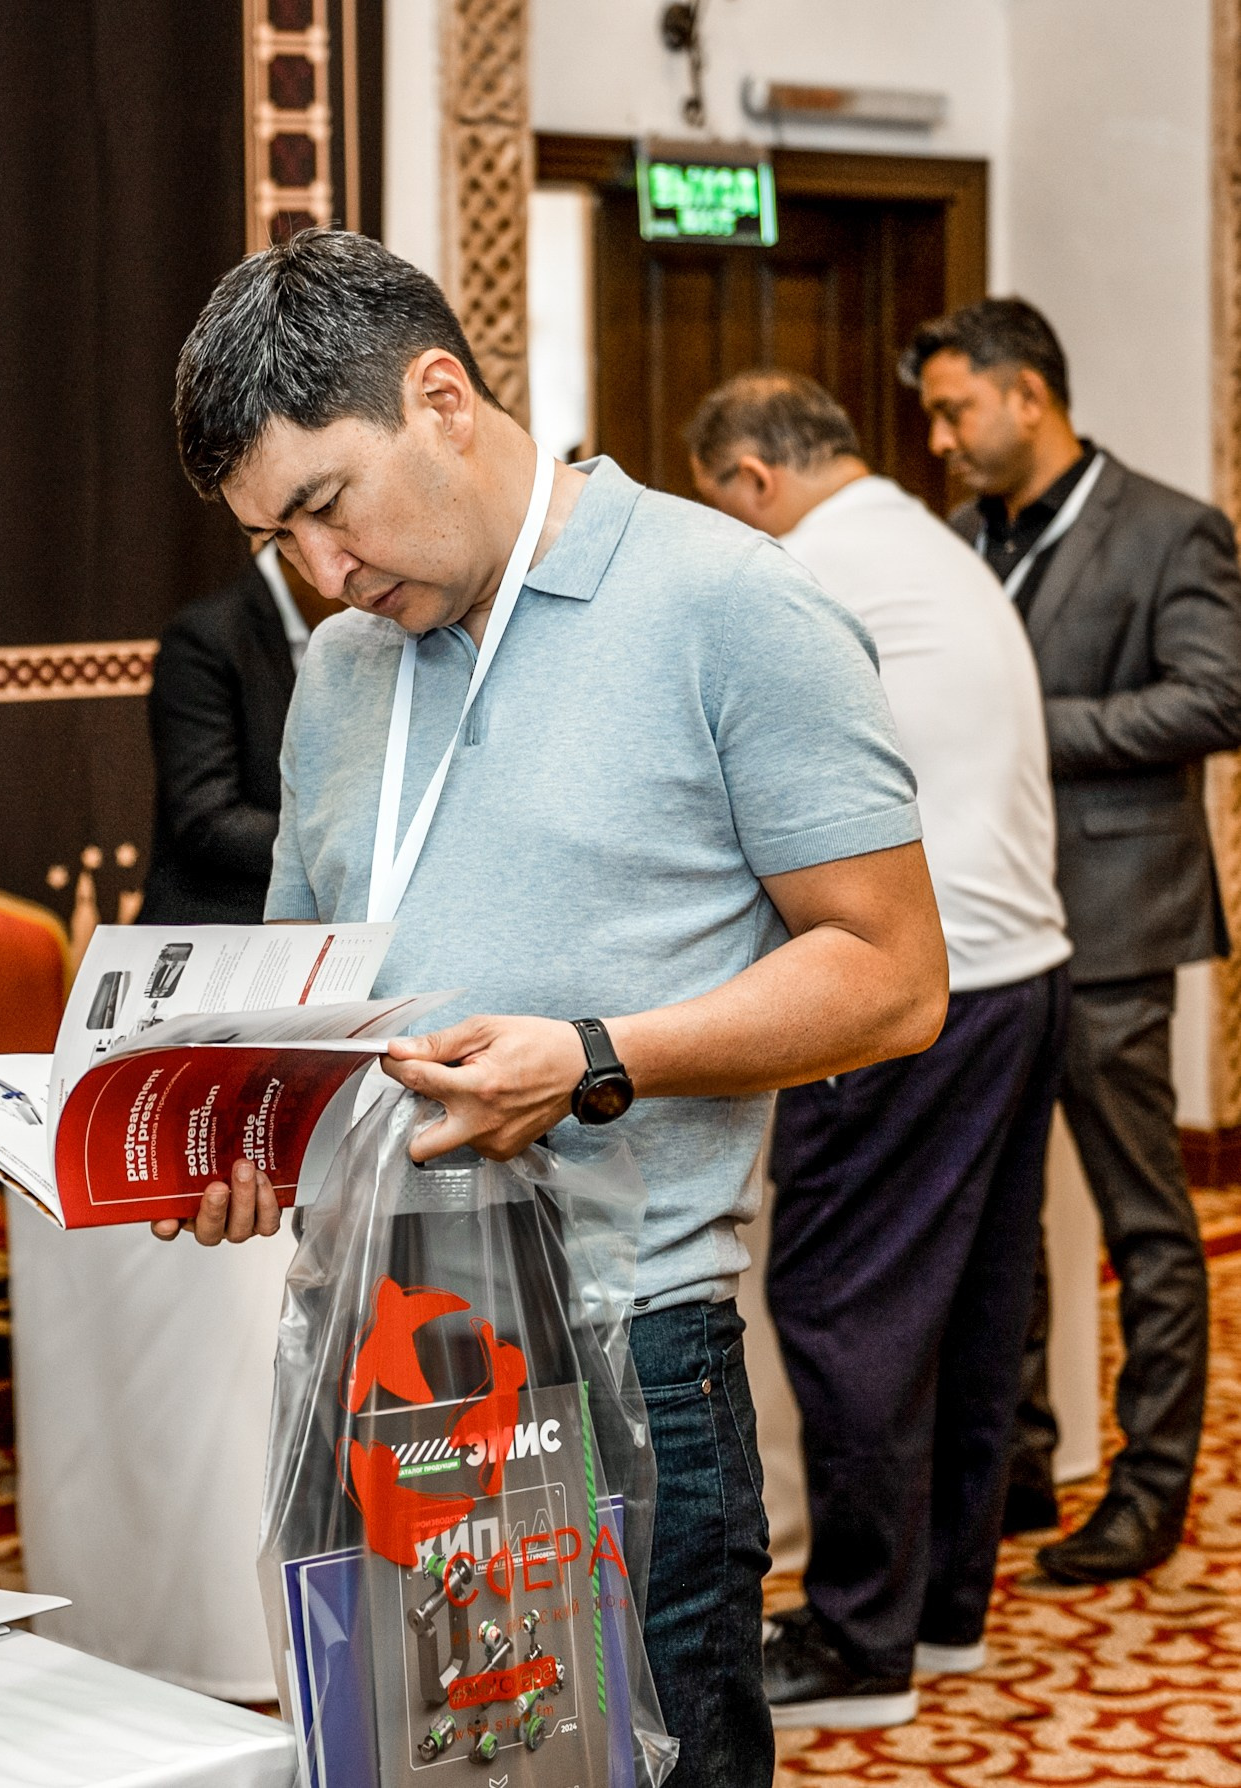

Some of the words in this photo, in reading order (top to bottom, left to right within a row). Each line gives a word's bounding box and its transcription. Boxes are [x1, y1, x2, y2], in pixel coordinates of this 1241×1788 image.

[124, 1068, 164, 1182] pretreatment
[137, 1093, 158, 1142] press
[197, 1085, 220, 1176] extraction
[255, 1078, 280, 1145] refinery
[135, 1144, 149, 1181] and
[185, 1108, 200, 1177] solvent
[243, 1114, 256, 1164] dible
[255, 1147, 267, 1171] oil
[560, 1722, 578, 1734] 2024
